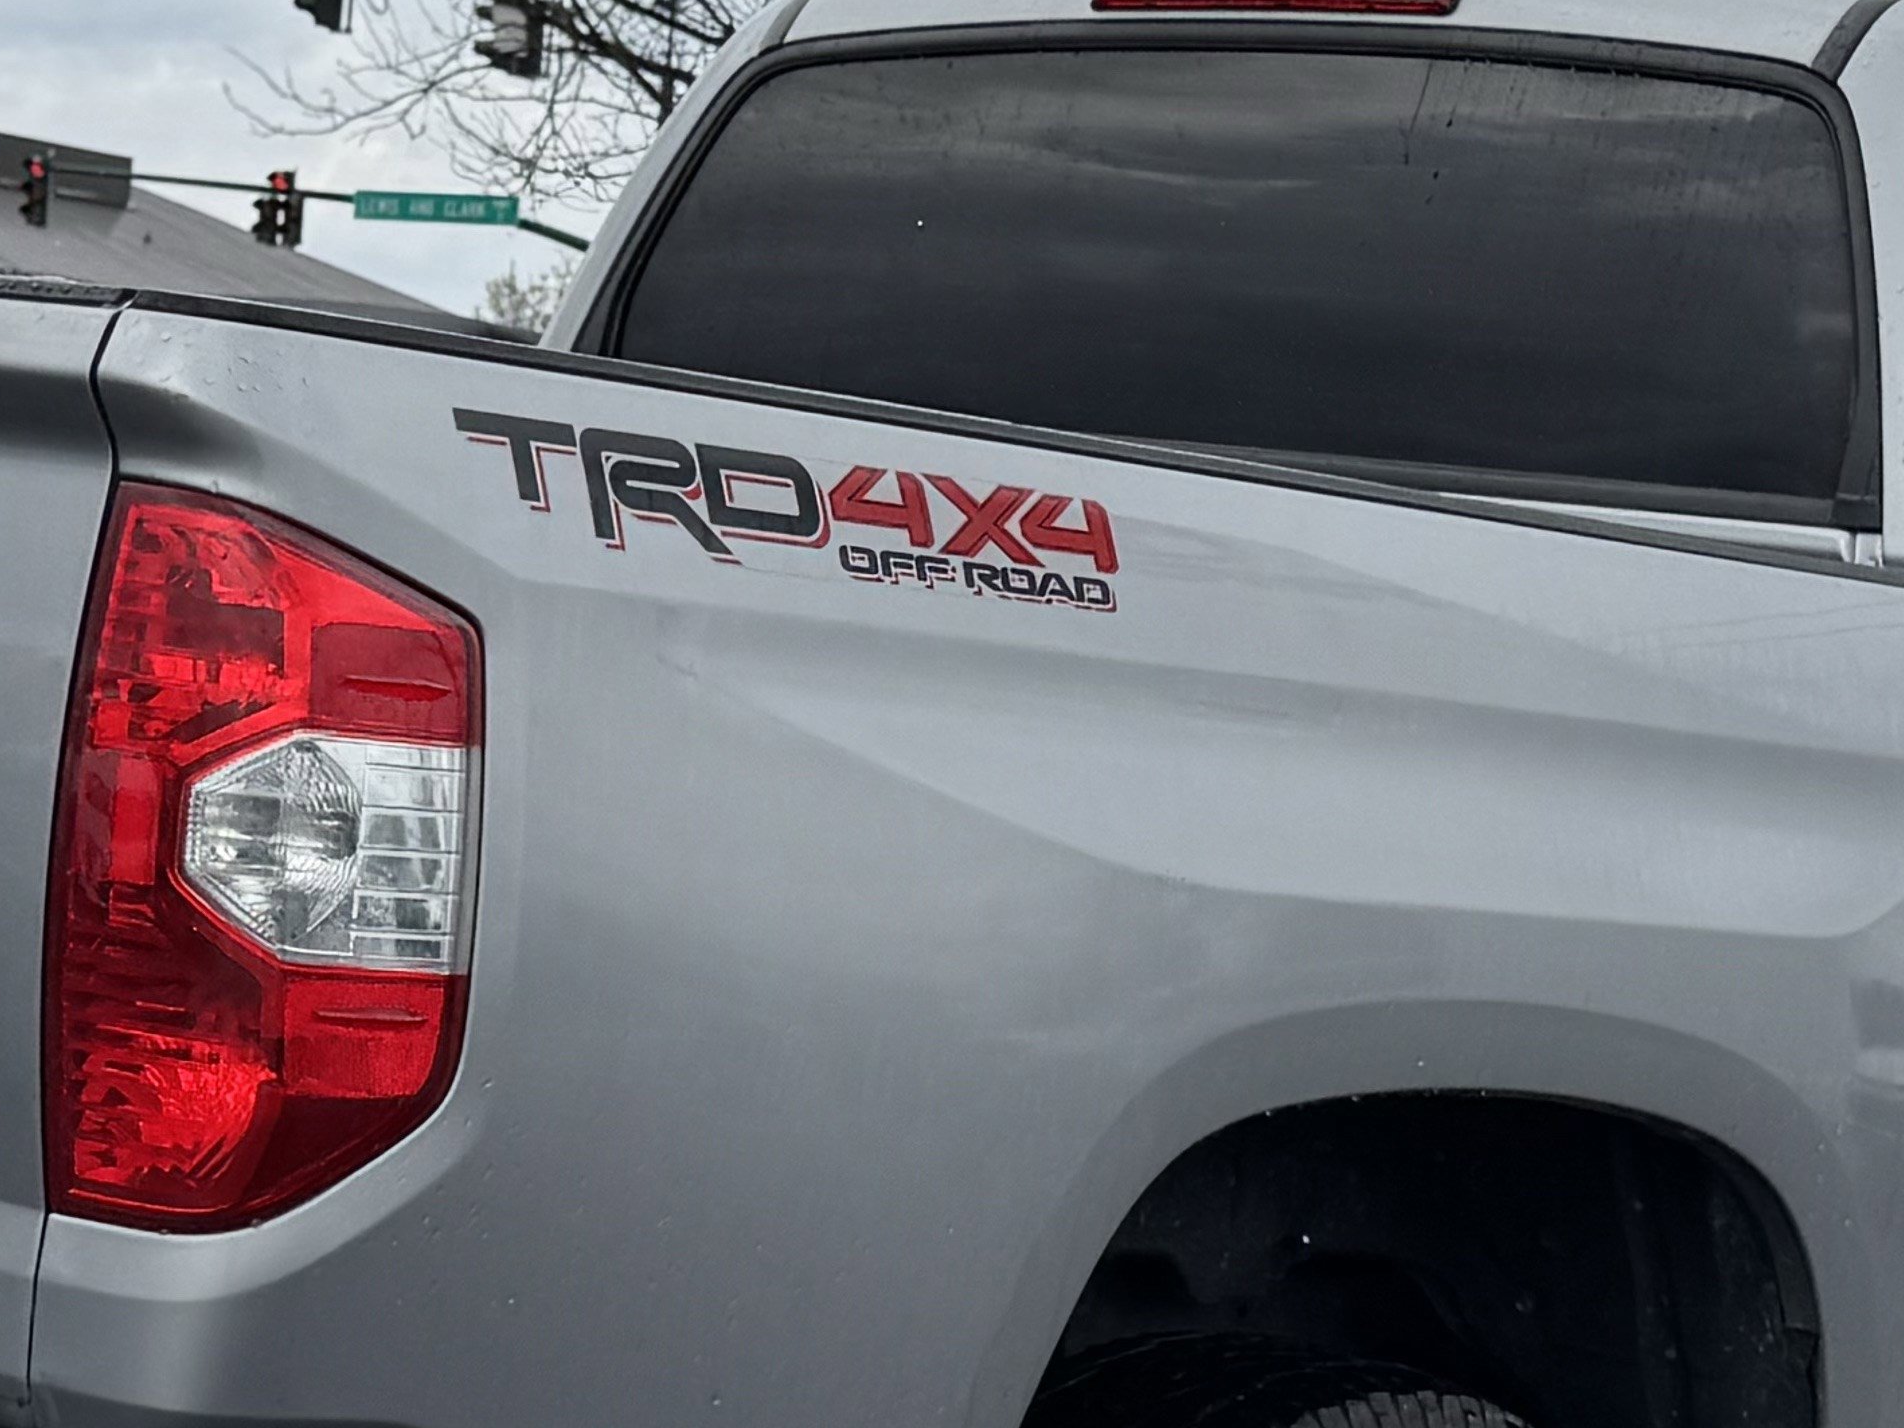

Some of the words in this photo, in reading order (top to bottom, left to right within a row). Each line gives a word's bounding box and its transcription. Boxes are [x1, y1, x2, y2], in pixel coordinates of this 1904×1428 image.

[452, 408, 831, 565] TRD
[839, 544, 957, 590] OFF
[962, 561, 1118, 613] ROAD
